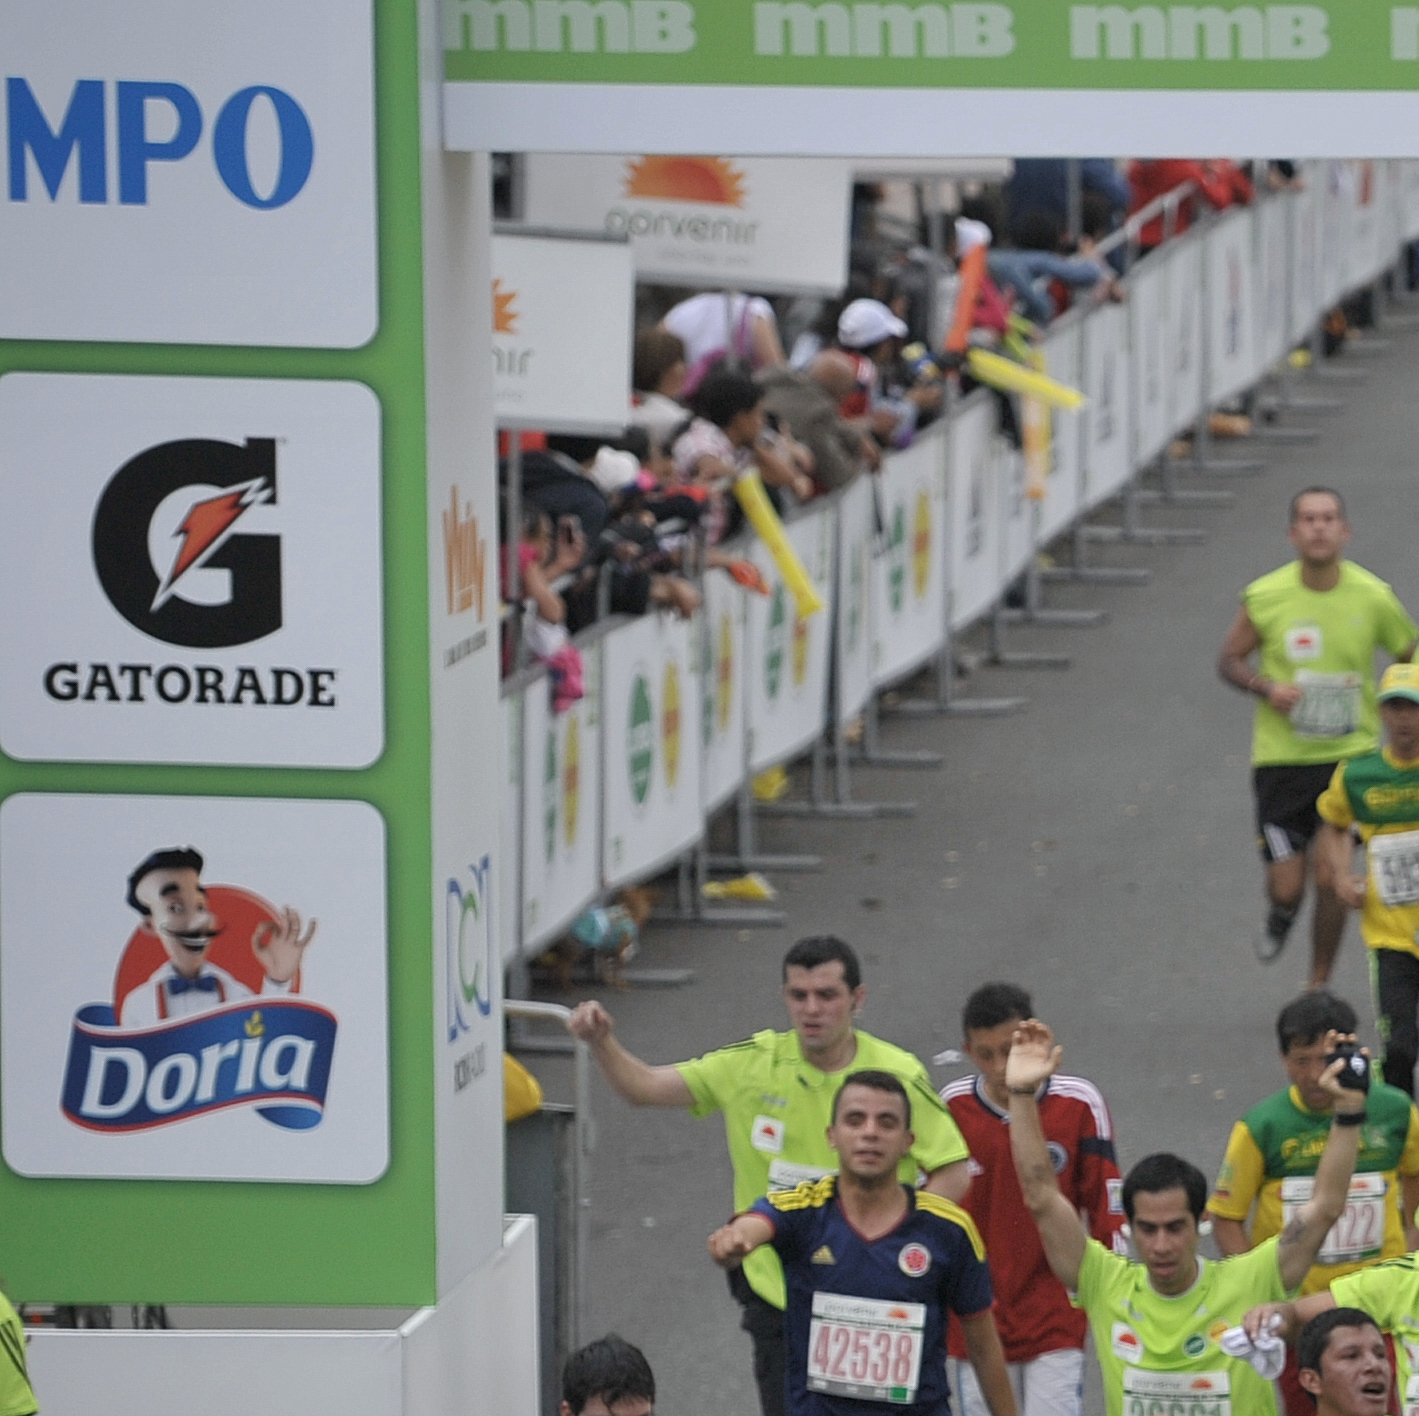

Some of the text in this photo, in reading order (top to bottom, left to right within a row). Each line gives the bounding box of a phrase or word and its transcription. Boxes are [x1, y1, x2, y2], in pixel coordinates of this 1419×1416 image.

[44, 663, 337, 708] GATORADE
[79, 1034, 315, 1119] Doria
[814, 1326, 913, 1385] 42538
